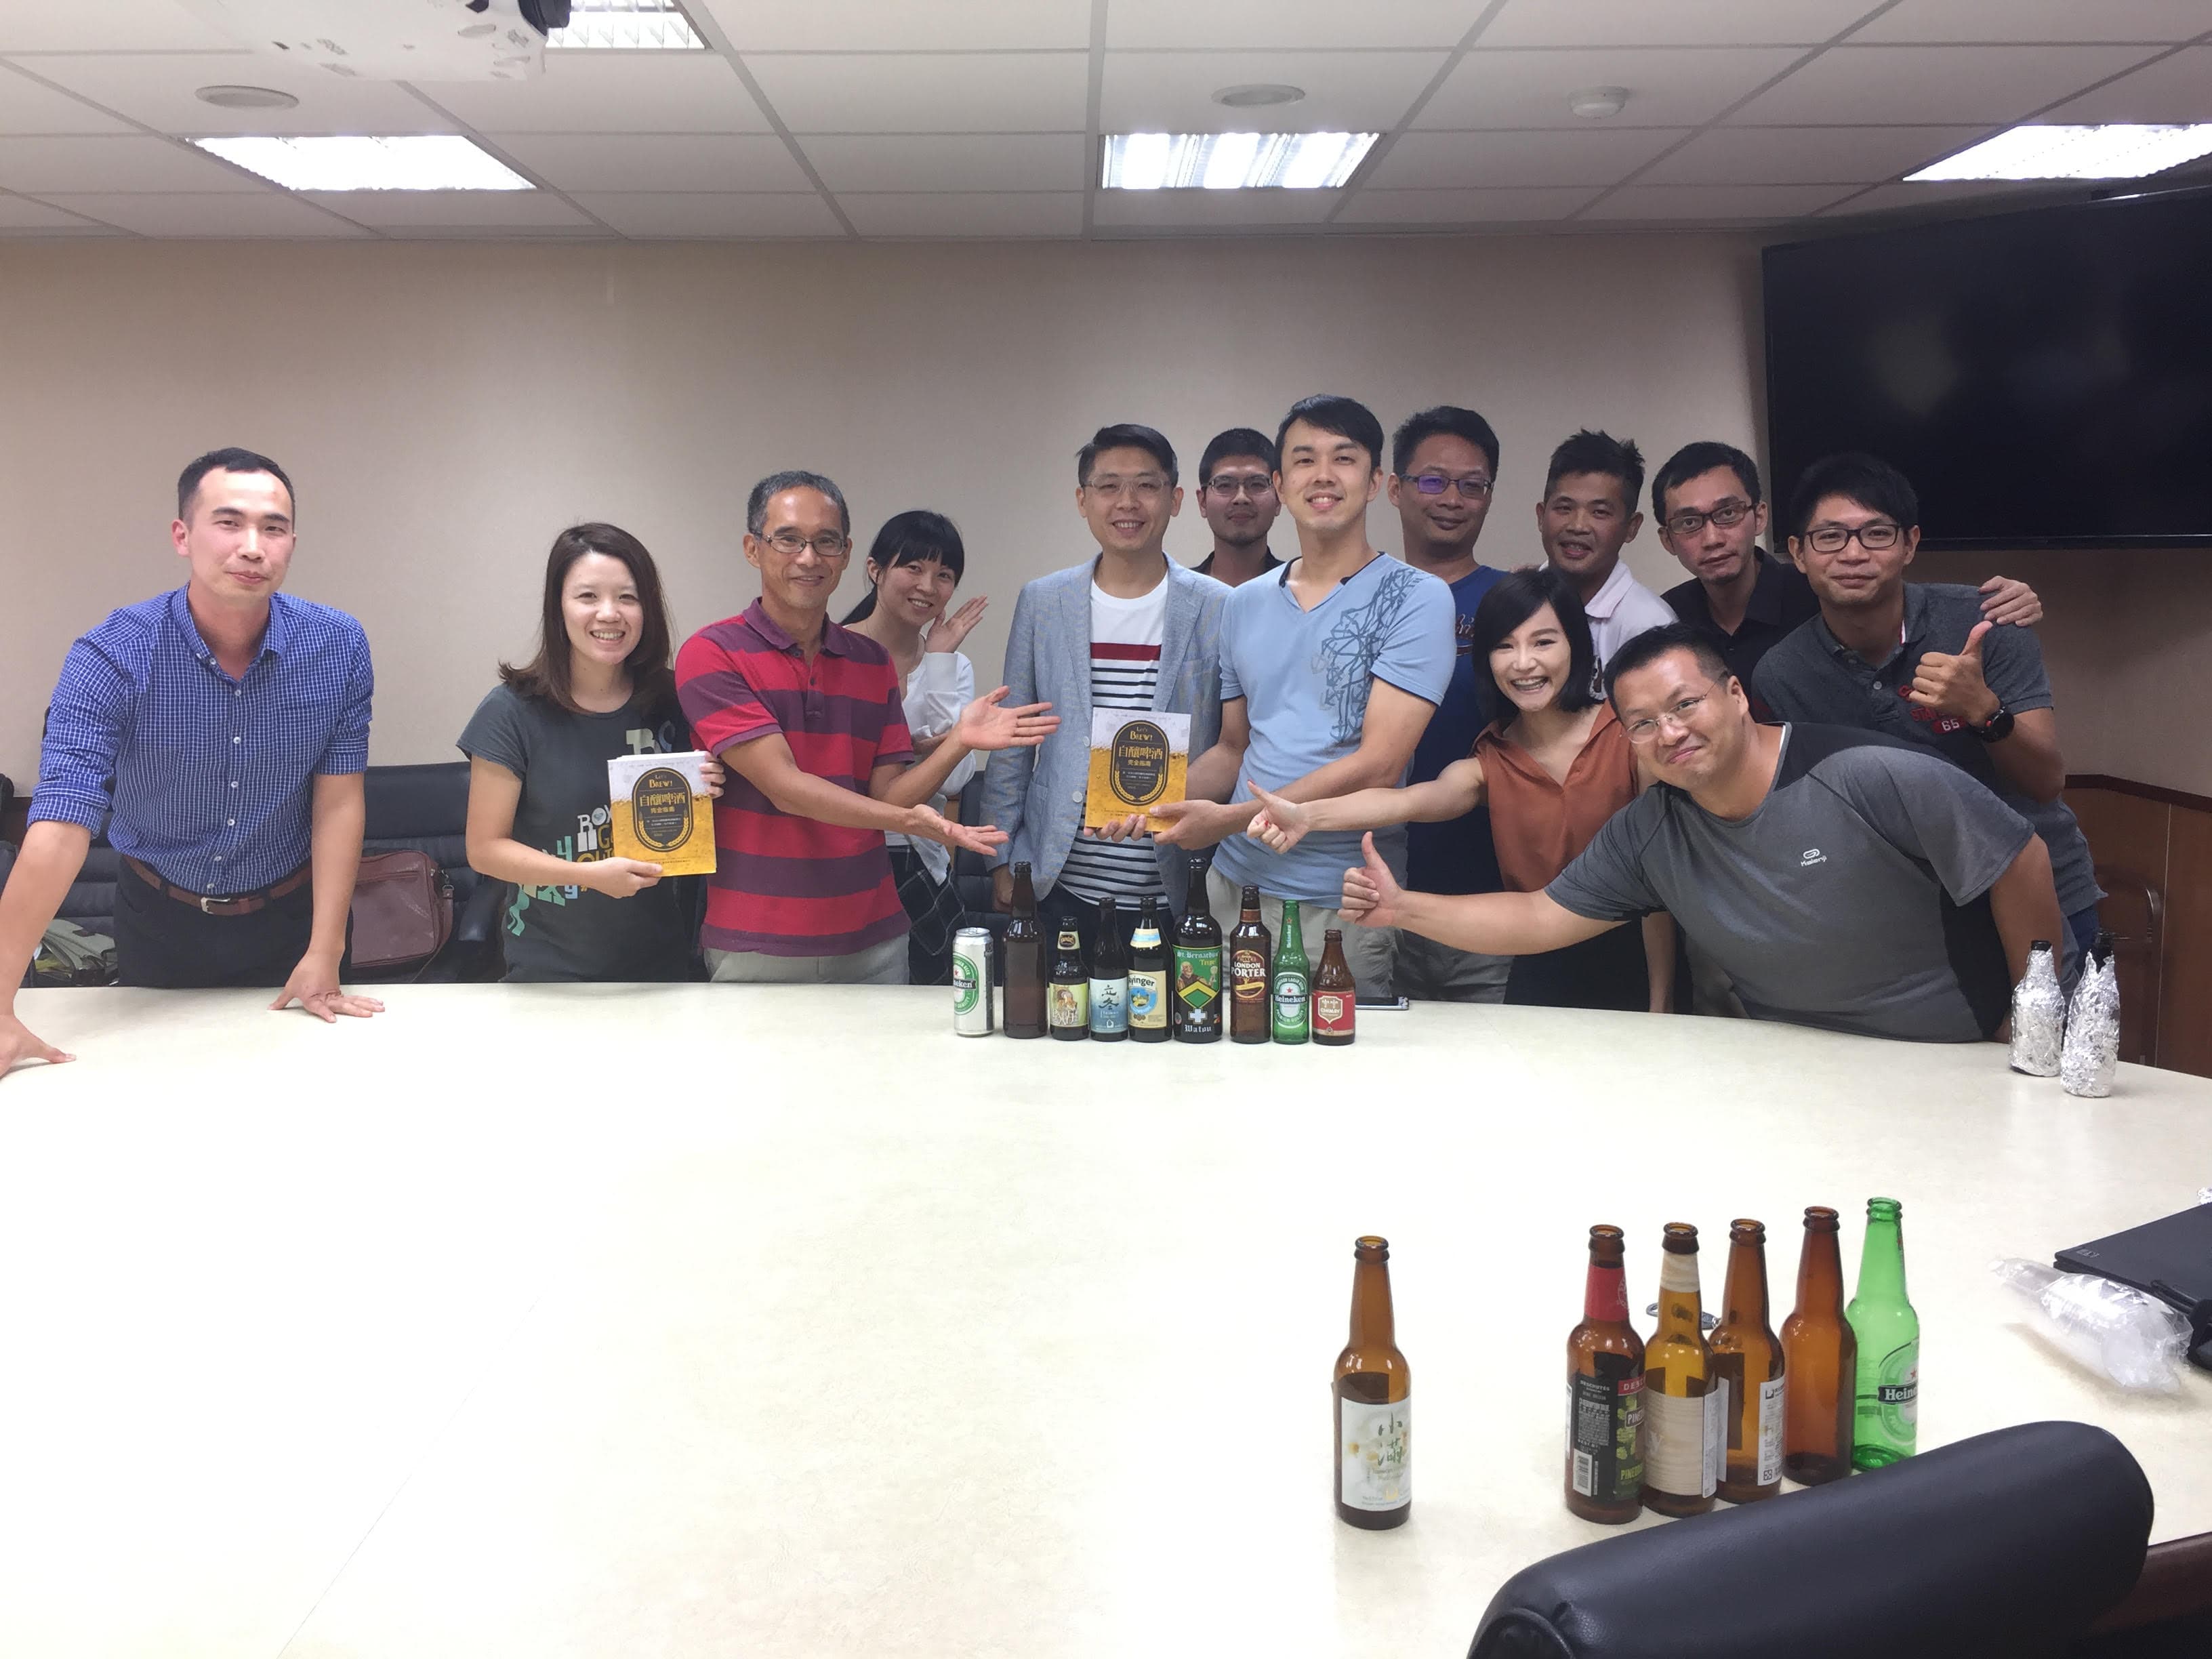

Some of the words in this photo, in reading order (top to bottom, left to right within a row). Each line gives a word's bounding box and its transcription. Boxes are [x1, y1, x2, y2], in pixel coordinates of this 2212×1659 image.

[1942, 718, 1960, 731] 65
[1118, 745, 1163, 760] 自釀啤酒
[640, 792, 686, 806] 自釀啤酒
[1231, 966, 1267, 978] PORTER
[1099, 985, 1120, 1010] 立冬
[1275, 995, 1306, 1003] Heineken
